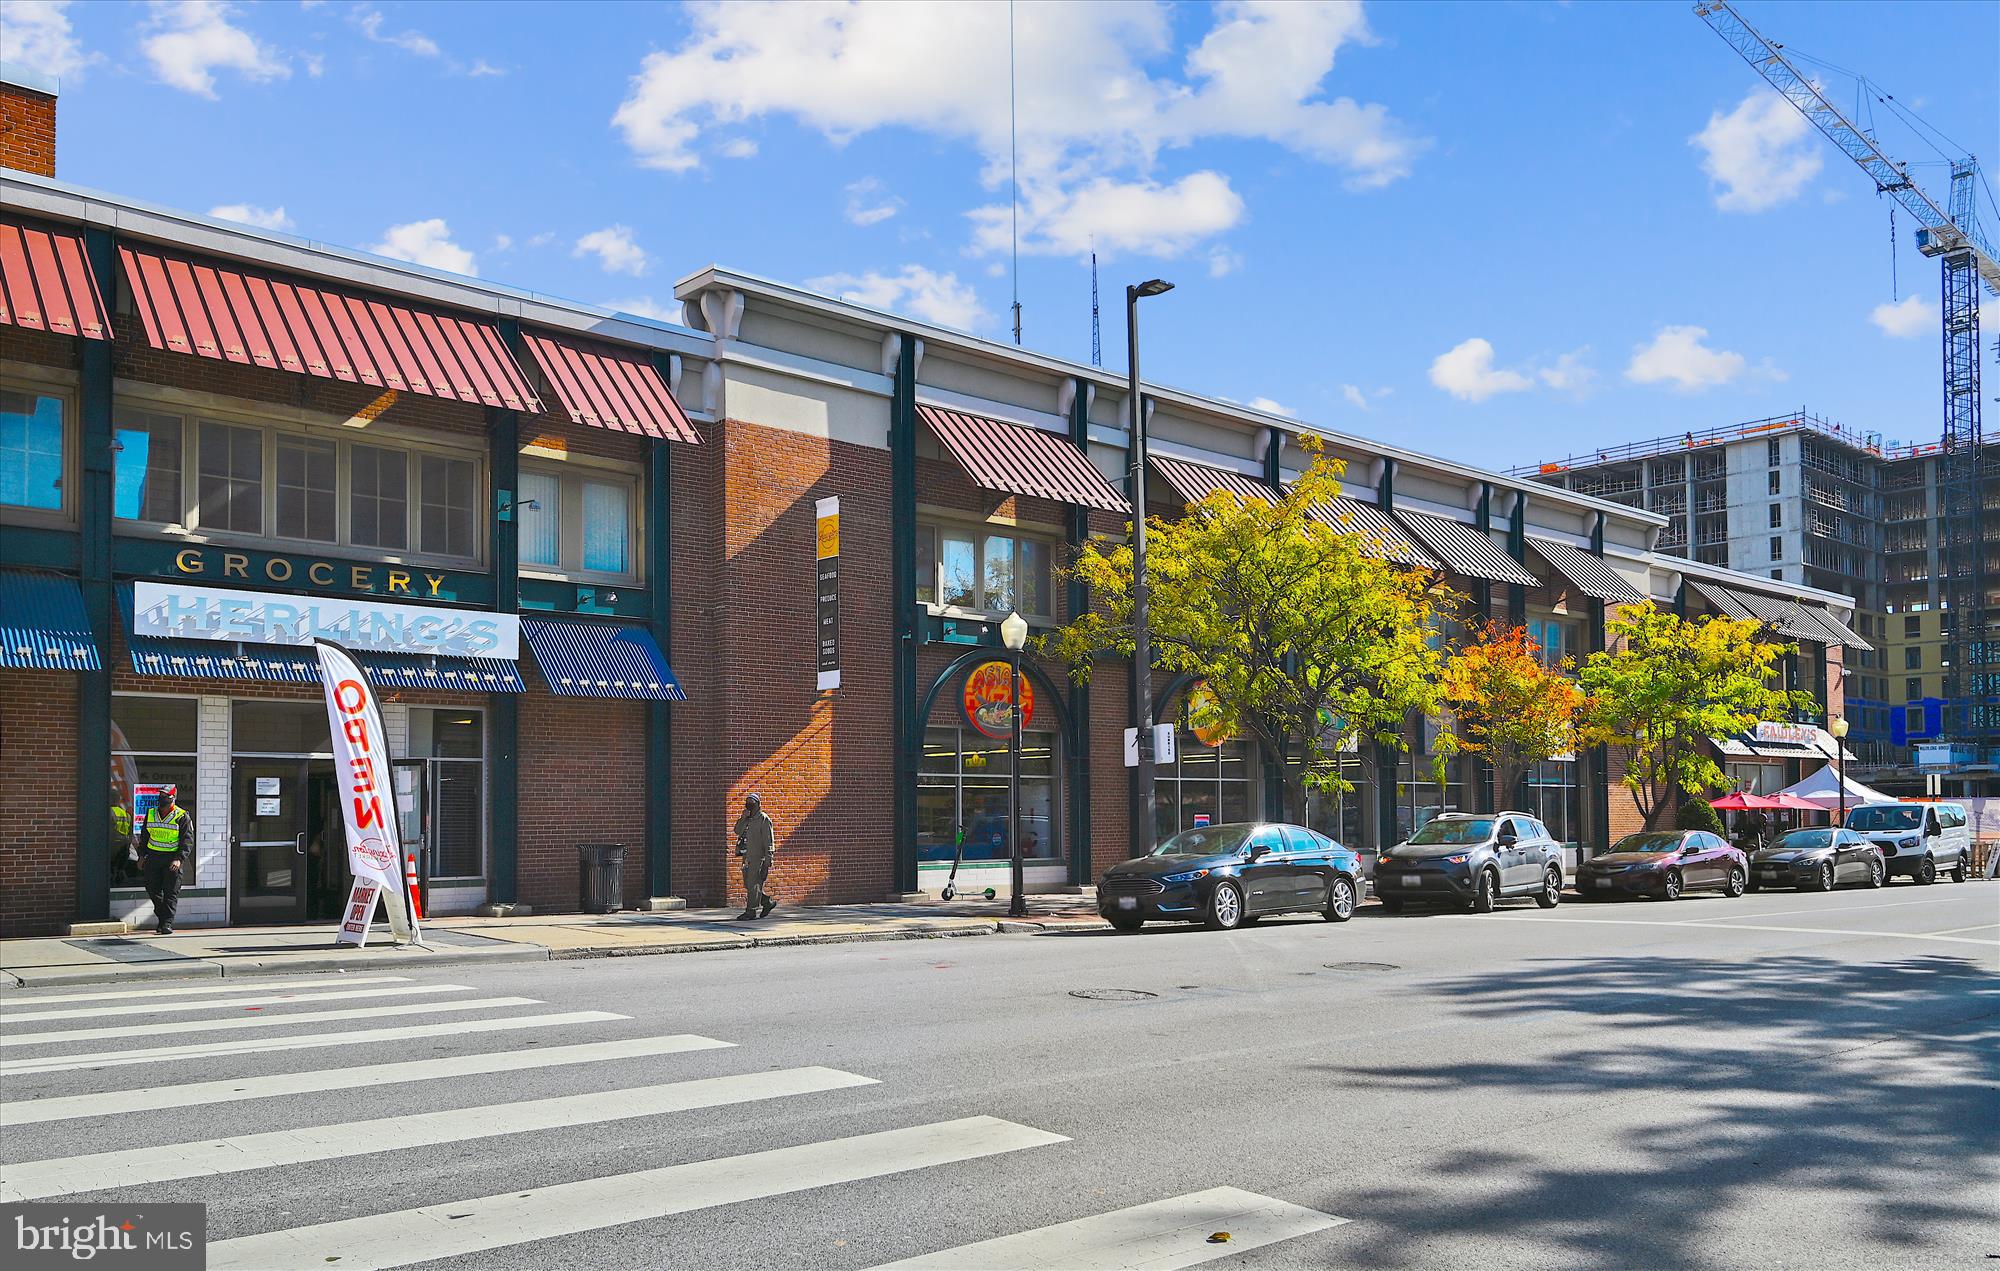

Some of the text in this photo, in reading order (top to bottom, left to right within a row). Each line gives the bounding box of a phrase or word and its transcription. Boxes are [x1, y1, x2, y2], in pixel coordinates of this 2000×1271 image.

[176, 549, 446, 596] GROCERY
[819, 571, 837, 581] SEAFOOD
[820, 593, 837, 603] PRODUCE
[166, 594, 499, 652] HERLING'S
[823, 617, 834, 626] MEAT
[822, 639, 835, 648] BAKED
[822, 647, 835, 656] GOODS
[352, 887, 376, 904] MARKET
[350, 904, 366, 921] OPEN
